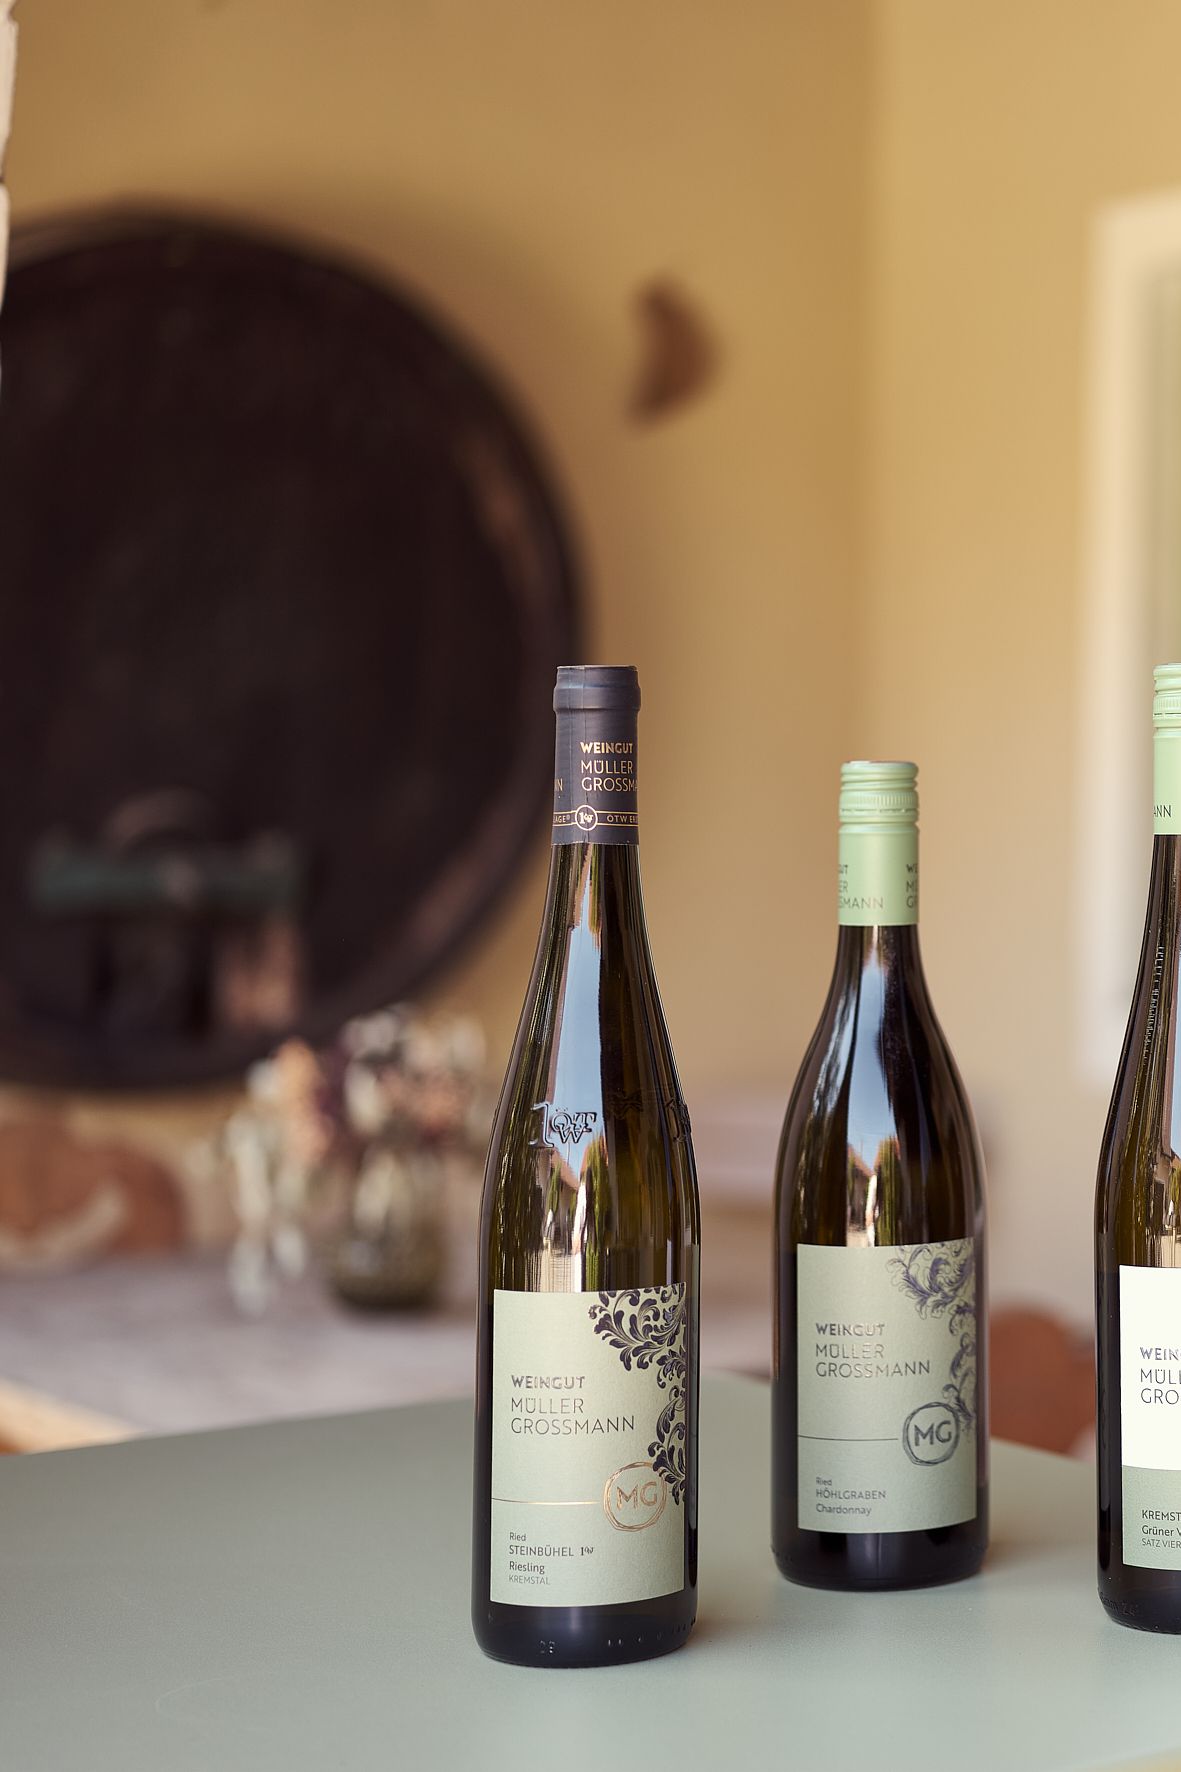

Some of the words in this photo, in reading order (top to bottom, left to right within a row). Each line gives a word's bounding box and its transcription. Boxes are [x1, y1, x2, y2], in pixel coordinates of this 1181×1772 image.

[580, 741, 633, 754] WEINGUT
[581, 759, 633, 774] MÜLLER
[815, 1322, 885, 1337] WEINGUT
[815, 1360, 931, 1379] GROSSMANN
[511, 1374, 586, 1390] WEINGUT
[511, 1397, 584, 1415] MÜLLER
[511, 1415, 635, 1437] GROSSMANN
[914, 1420, 953, 1447] MG
[616, 1481, 659, 1511] MG
[816, 1487, 887, 1500] HÖHLGRABEN
[816, 1503, 872, 1517] Chardonnay
[509, 1532, 527, 1541] Ried
[1142, 1525, 1175, 1537] Grüner
[1142, 1538, 1160, 1548] SATZ
[509, 1545, 574, 1557] STEINBÜHEL
[509, 1561, 545, 1575] Riesling
[509, 1575, 551, 1586] KREMSTAL
